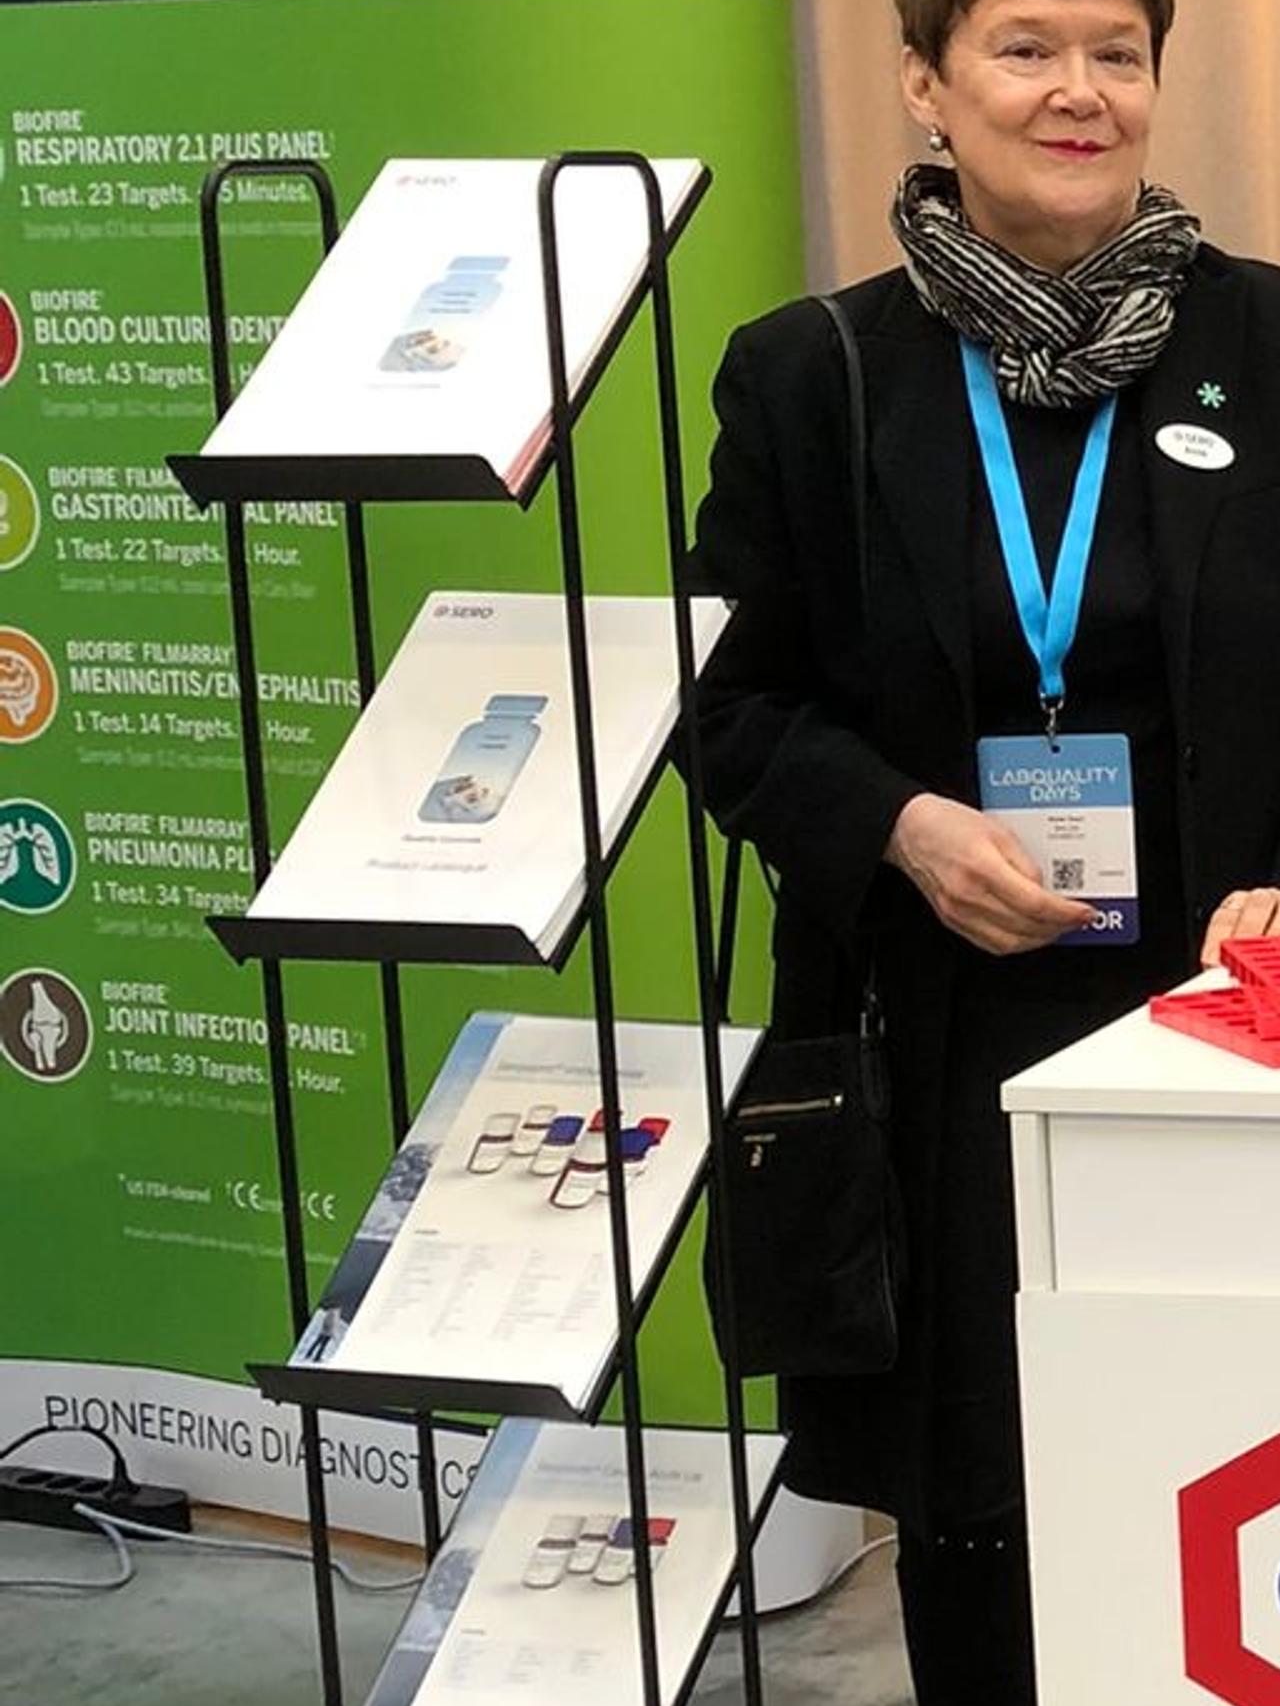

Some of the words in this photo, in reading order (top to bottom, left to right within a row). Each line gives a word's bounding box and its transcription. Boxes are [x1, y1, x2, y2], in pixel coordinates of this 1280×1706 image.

[16, 134, 173, 167] RESPIRATORY
[178, 134, 205, 163] 2.1
[211, 132, 262, 161] PLUS
[20, 183, 31, 208] 1
[36, 182, 85, 208] Test.
[87, 182, 114, 207] 23
[119, 181, 194, 211] Targets.
[34, 315, 115, 344] BLOOD
[38, 363, 48, 385] 1
[54, 362, 101, 385] Test.
[105, 362, 132, 385] 43
[135, 362, 211, 390] Targets.
[55, 538, 67, 561] 1
[70, 538, 119, 561] Test.
[122, 538, 148, 561] 22
[150, 538, 225, 567] Targets.
[254, 542, 302, 566] Hour.
[69, 667, 361, 708] MENINGITIS/ENEPHALITIS
[73, 710, 85, 733] 1
[90, 710, 136, 734] Test.
[139, 712, 162, 735] 14
[164, 712, 238, 742] Targets.
[266, 720, 316, 744] Hour.
[989, 766, 1119, 787] LABQUALITY
[1029, 784, 1082, 802] DAYS
[87, 838, 222, 870] PNEUMONIA
[91, 882, 101, 904] 1
[105, 882, 151, 905] Test.
[155, 884, 181, 907] 34
[104, 1007, 170, 1035] JOINT
[174, 1010, 269, 1046] INFECTIO
[107, 1049, 119, 1071] 1
[121, 1050, 168, 1074] Test.
[171, 1053, 197, 1076] 39
[44, 1392, 253, 1459] PIONEERING
